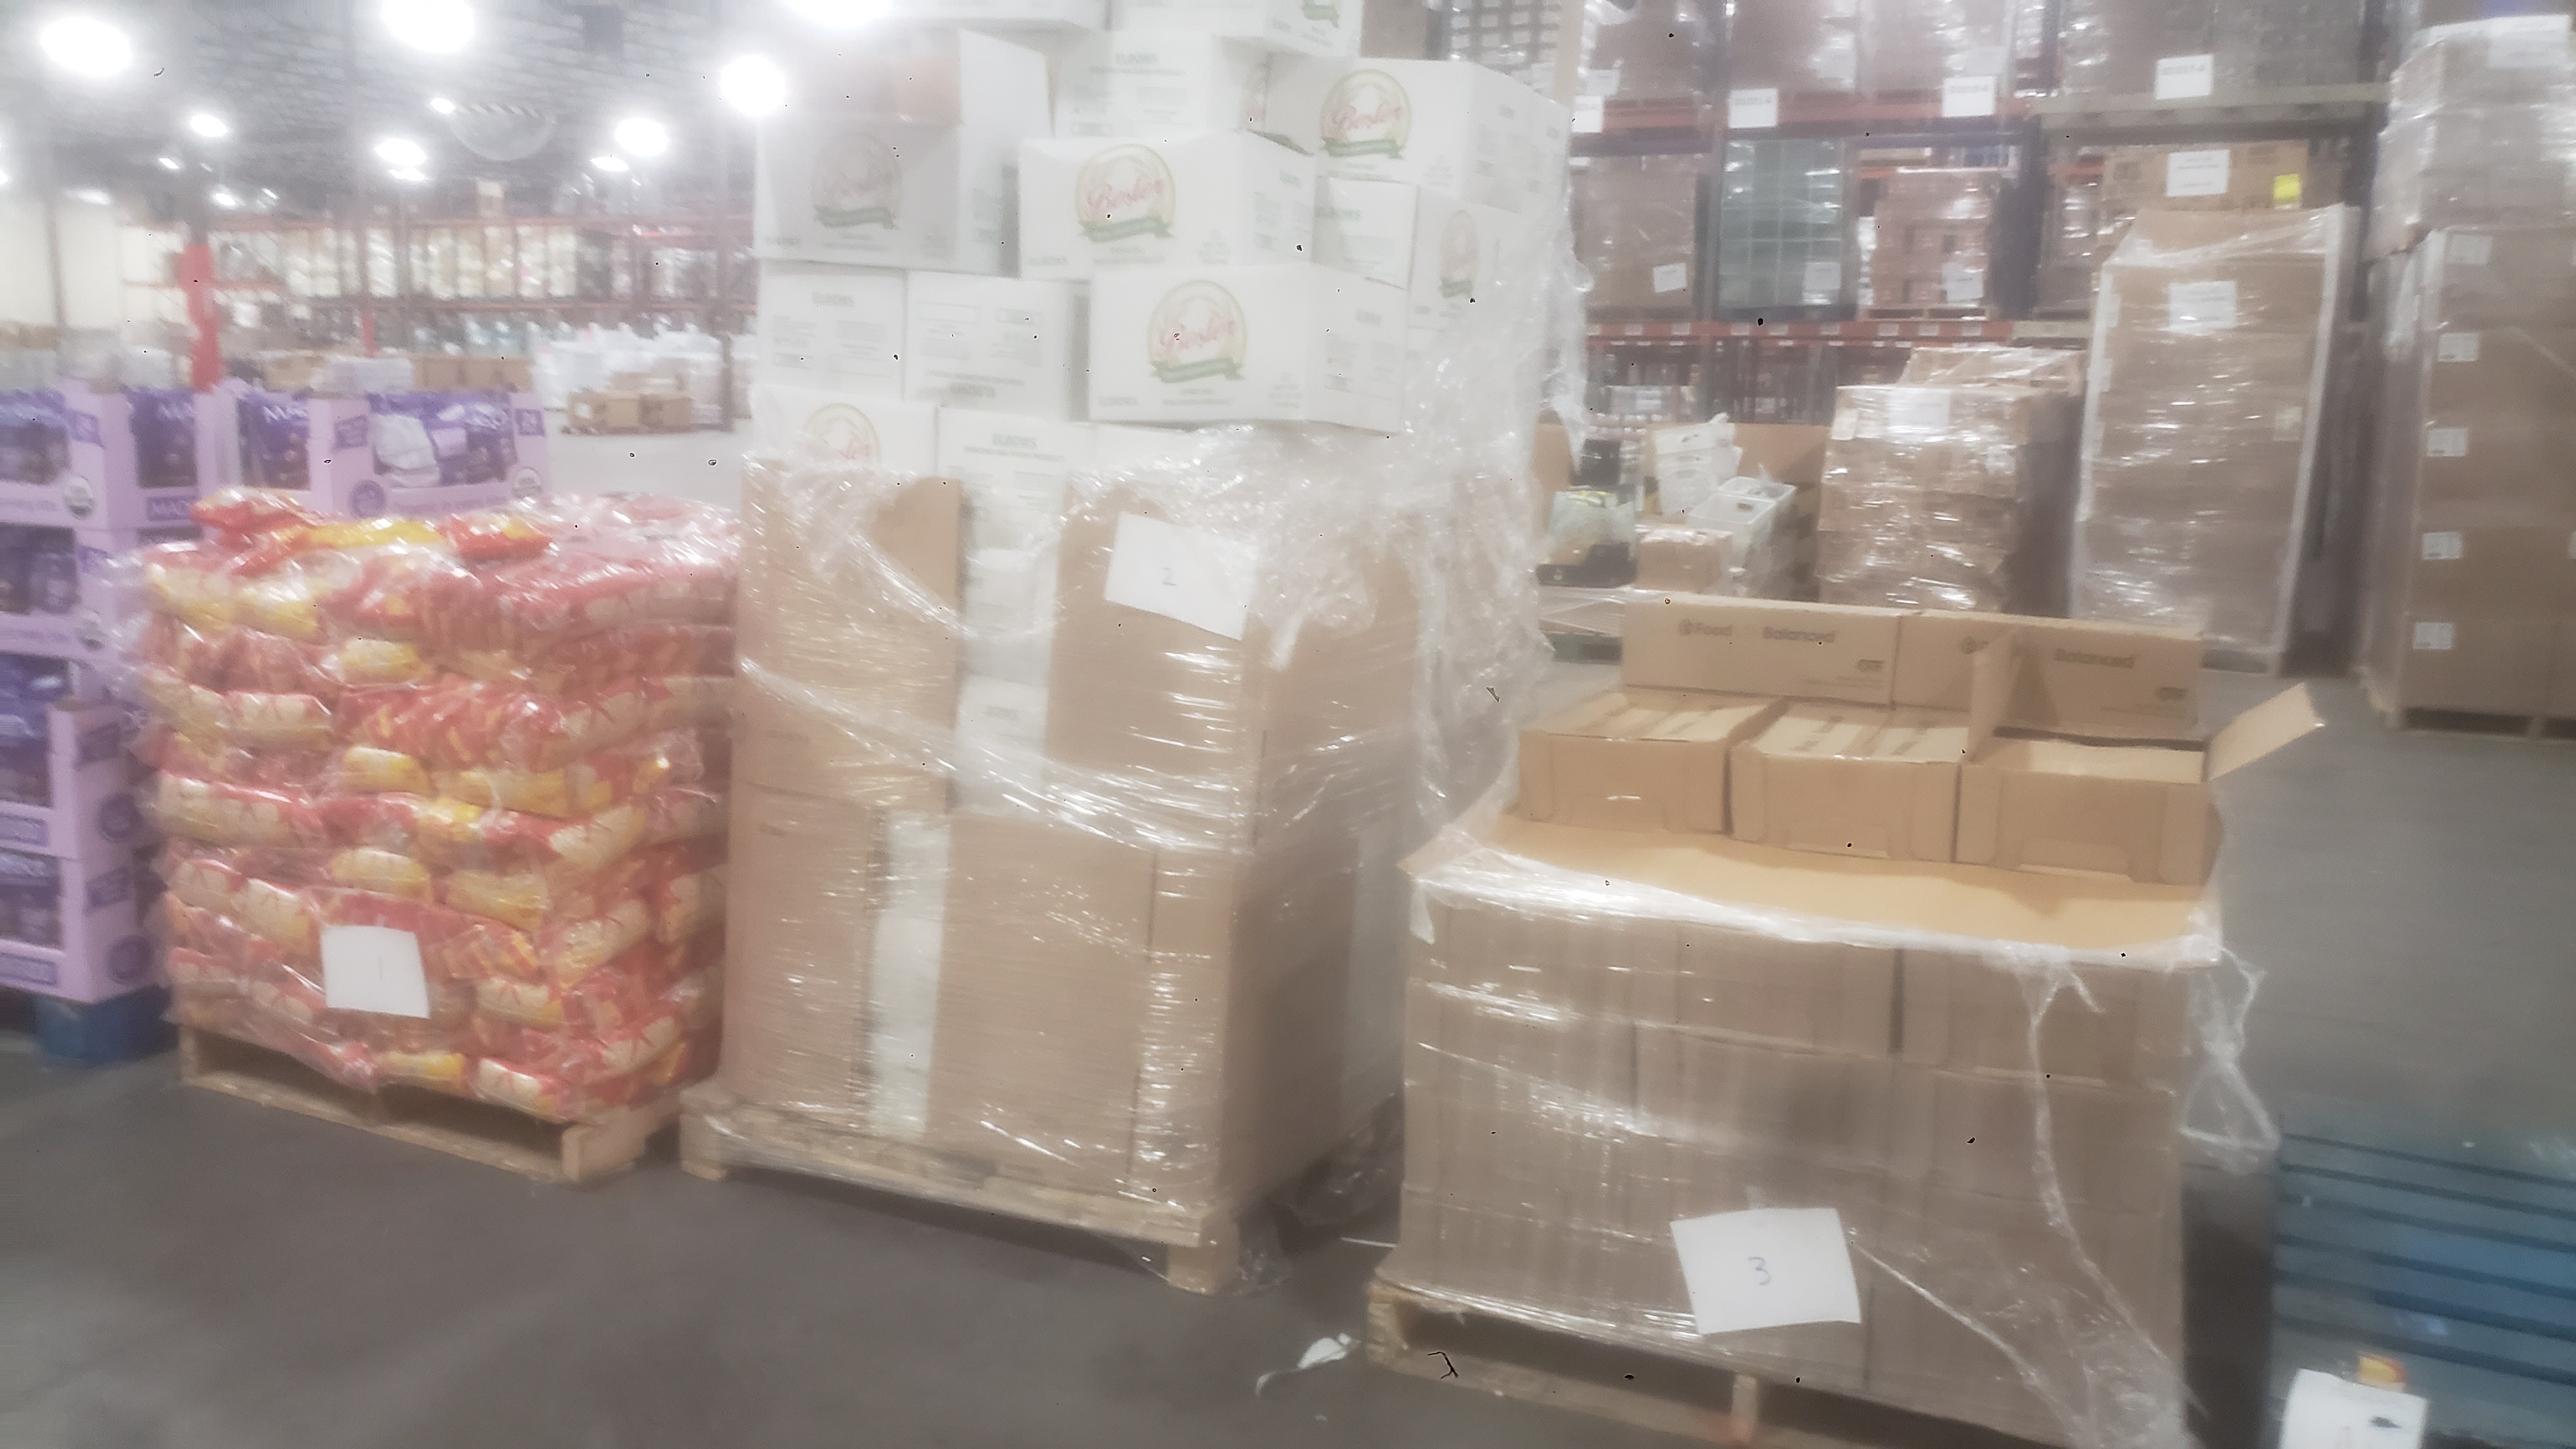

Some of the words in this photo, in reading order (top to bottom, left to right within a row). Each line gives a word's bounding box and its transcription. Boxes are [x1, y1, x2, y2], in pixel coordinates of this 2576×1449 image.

[1161, 567, 1178, 587] 2
[1762, 625, 1837, 643] Balanced
[2054, 647, 2136, 669] Balanced
[1747, 1255, 1772, 1286] 3
